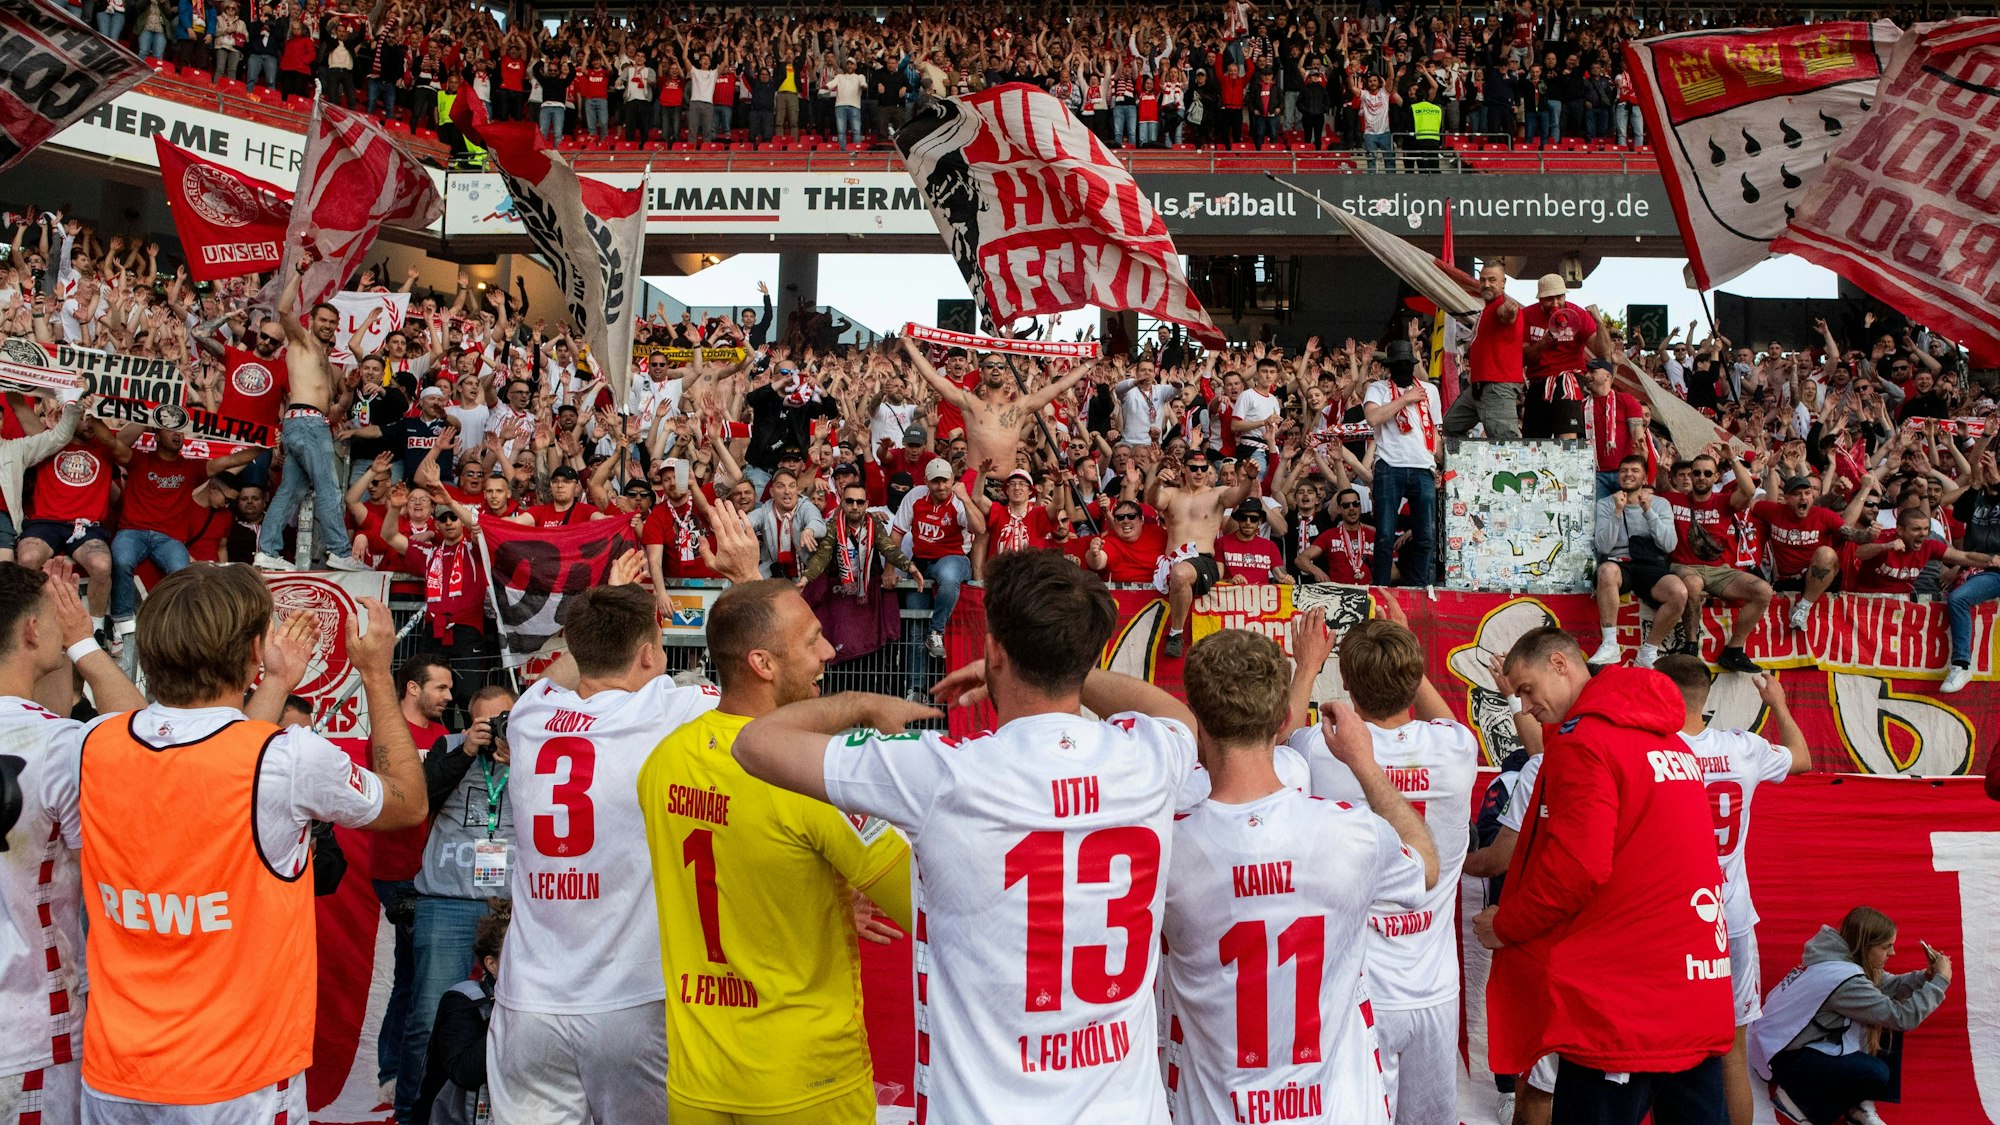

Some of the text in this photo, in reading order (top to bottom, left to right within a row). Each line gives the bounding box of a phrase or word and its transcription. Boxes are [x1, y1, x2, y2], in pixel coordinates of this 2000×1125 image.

[84, 103, 229, 157] HERME
[647, 187, 929, 210] ELMANN THERM
[1188, 192, 1297, 216] Fußball
[1342, 190, 1650, 223] stadion-nuernberg.de
[203, 243, 278, 262] UNSER
[192, 410, 269, 446] ULTRA
[918, 521, 940, 538] VPV
[533, 736, 596, 858] 3
[1051, 775, 1099, 819] UTH
[1385, 765, 1430, 793] ÜBERS
[667, 783, 731, 827] SCHWÄBE
[557, 867, 600, 900] KÖLN
[682, 828, 728, 965] 1
[1232, 860, 1295, 899] KAINZ
[97, 881, 233, 936] REWE
[1004, 826, 1161, 1013] 13
[1400, 910, 1433, 936] KÖLN
[694, 974, 715, 1006] FC
[717, 971, 758, 1009] KÖLN
[1218, 915, 1325, 1070] 11
[1071, 1019, 1130, 1068] KÖLN
[1272, 1081, 1322, 1121] KÖLN
